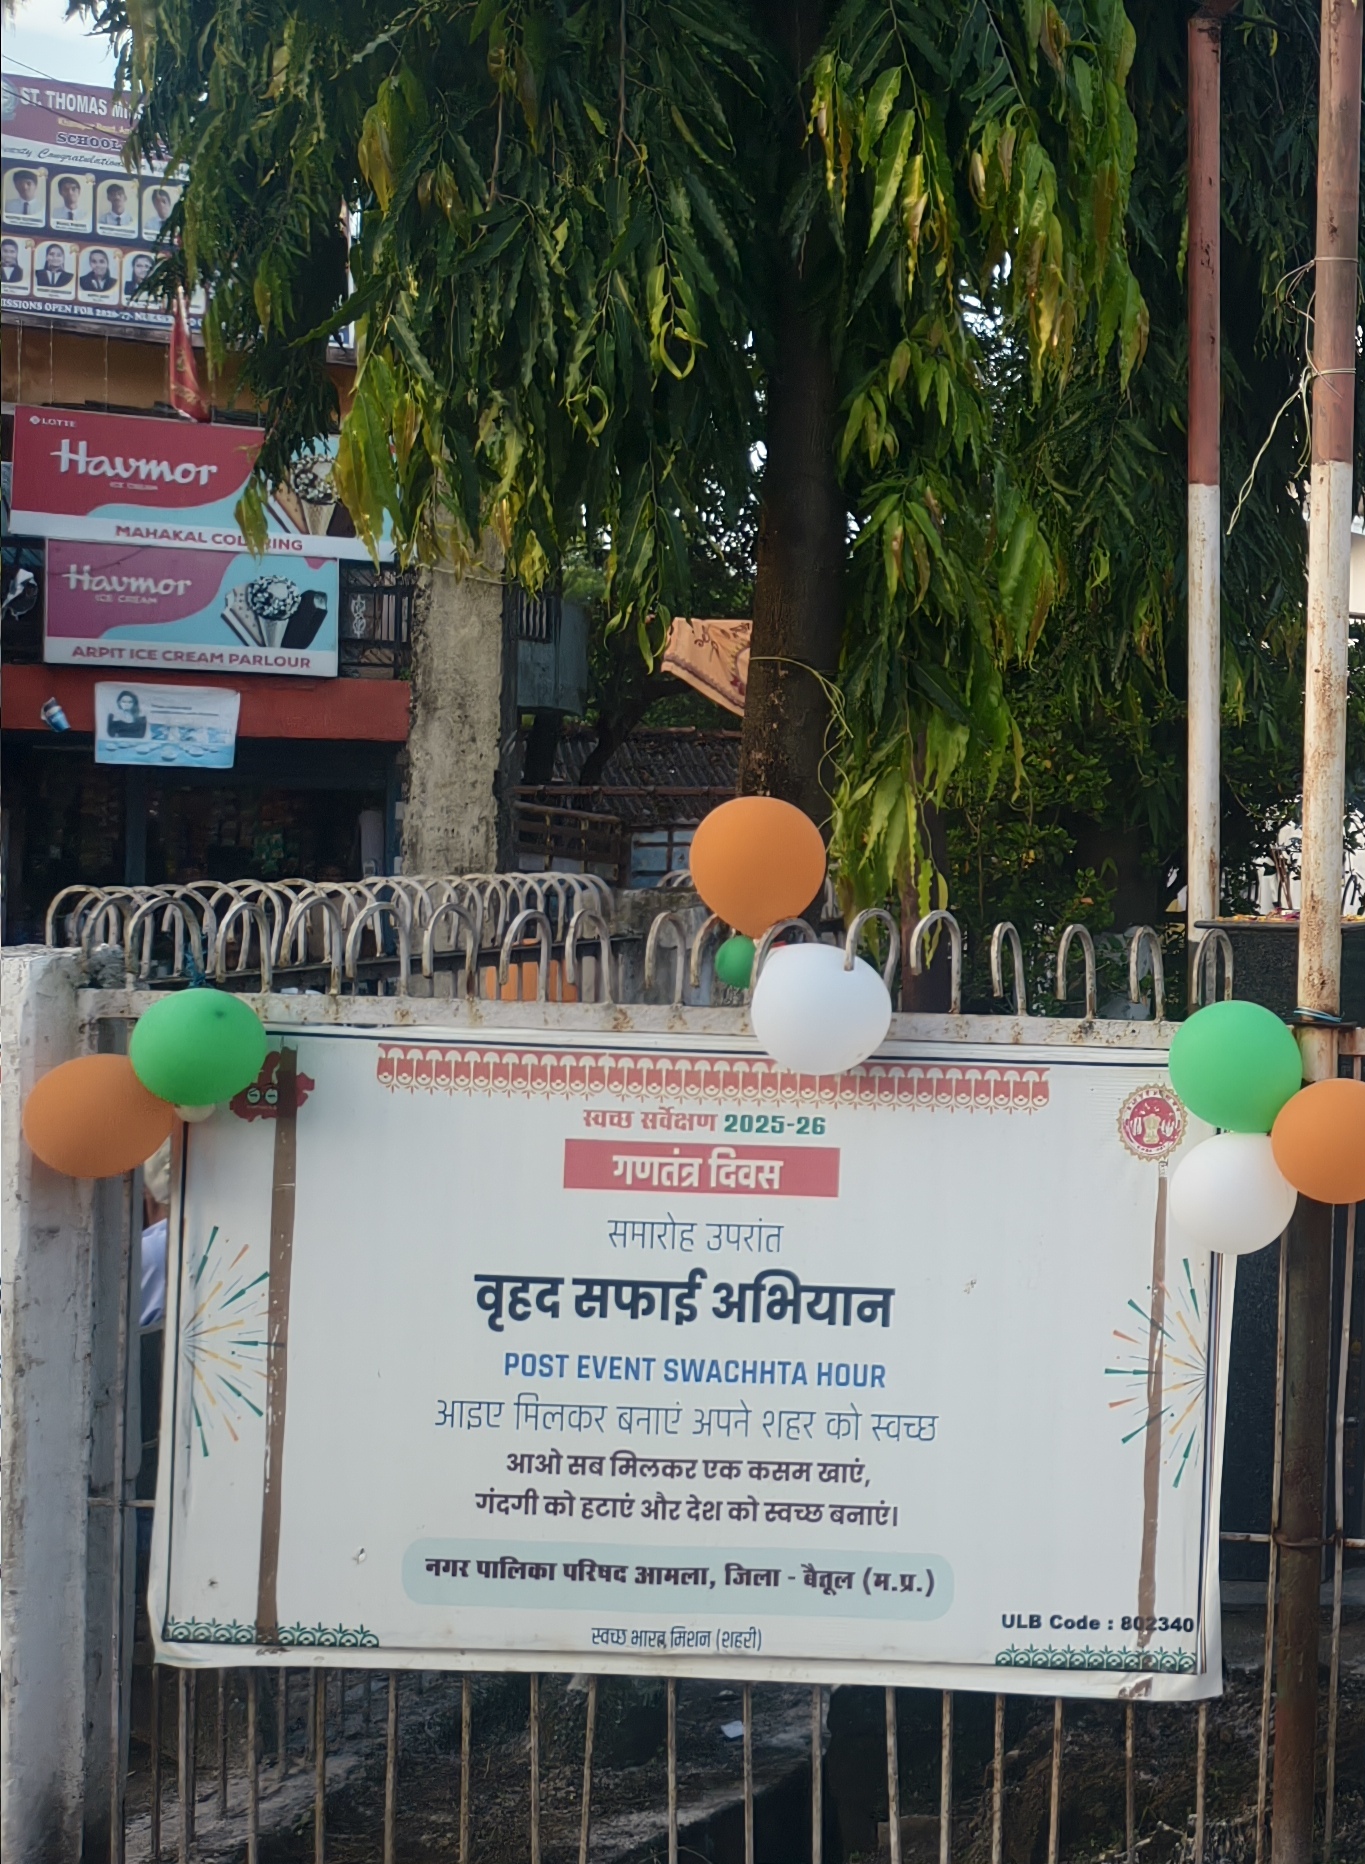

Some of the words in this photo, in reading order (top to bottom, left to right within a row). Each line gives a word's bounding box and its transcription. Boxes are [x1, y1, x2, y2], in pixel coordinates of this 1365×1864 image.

[20, 87, 42, 107] ST.
[45, 90, 108, 116] THOMAS
[57, 132, 122, 152] SCHOOL
[44, 302, 72, 314] OPEN
[74, 305, 93, 315] FOR
[42, 418, 77, 428] LOTTE
[50, 438, 218, 486] Havmor
[115, 524, 207, 544] MAHAKAL
[62, 564, 192, 596] Havmor
[72, 645, 126, 659] ARPIT
[129, 648, 158, 661] ICE
[162, 650, 224, 665] CREAM
[229, 653, 311, 669] PARLOUR
[583, 1108, 634, 1129] स्वच्छ
[640, 1105, 719, 1132] सर्वेक्षण
[723, 1112, 827, 1136] 2025-26
[612, 1147, 703, 1189] गणतंत्र
[708, 1146, 784, 1190] दिवस
[607, 1211, 698, 1253] समारोह
[706, 1216, 785, 1254] उपरांत
[474, 1272, 565, 1332] वृहद
[572, 1267, 708, 1326] सफाई
[712, 1268, 896, 1328] अभियान
[504, 1352, 570, 1379] POST
[577, 1355, 657, 1382] EVENT
[663, 1358, 808, 1386] SWACHHTA
[817, 1362, 886, 1388] HOUR
[435, 1399, 505, 1431] आइए
[513, 1391, 609, 1434] मिलकर
[616, 1400, 683, 1436] बनाएं
[692, 1398, 753, 1438] अपने
[762, 1410, 817, 1441] शहर
[825, 1401, 863, 1442] को
[871, 1413, 940, 1443] स्वच्छ
[506, 1447, 564, 1476] आओ
[567, 1455, 607, 1477] सब
[609, 1449, 698, 1480] मिलकर
[702, 1459, 744, 1481] एक
[747, 1460, 813, 1483] कसम
[817, 1457, 870, 1488] खाएं,
[474, 1486, 539, 1516] गंदगी
[543, 1489, 576, 1517] को
[580, 1492, 636, 1520] हटाएं
[640, 1491, 682, 1522] और
[685, 1493, 723, 1522] देश
[727, 1494, 760, 1523] को
[764, 1501, 826, 1524] स्वच्छ
[425, 1557, 472, 1578] नगर
[476, 1555, 558, 1582] पालिका
[563, 1558, 629, 1584] परिषद
[634, 1565, 716, 1590] आमला,
[724, 1562, 782, 1588] जिला
[801, 1562, 856, 1597] बैतूल
[591, 1626, 628, 1646] स्वच्छ
[669, 1625, 712, 1650] मिशन
[715, 1625, 762, 1652] (शहरी)
[1002, 1613, 1042, 1630] ULB
[1049, 1614, 1101, 1631] Code
[1120, 1615, 1195, 1633] 802340
